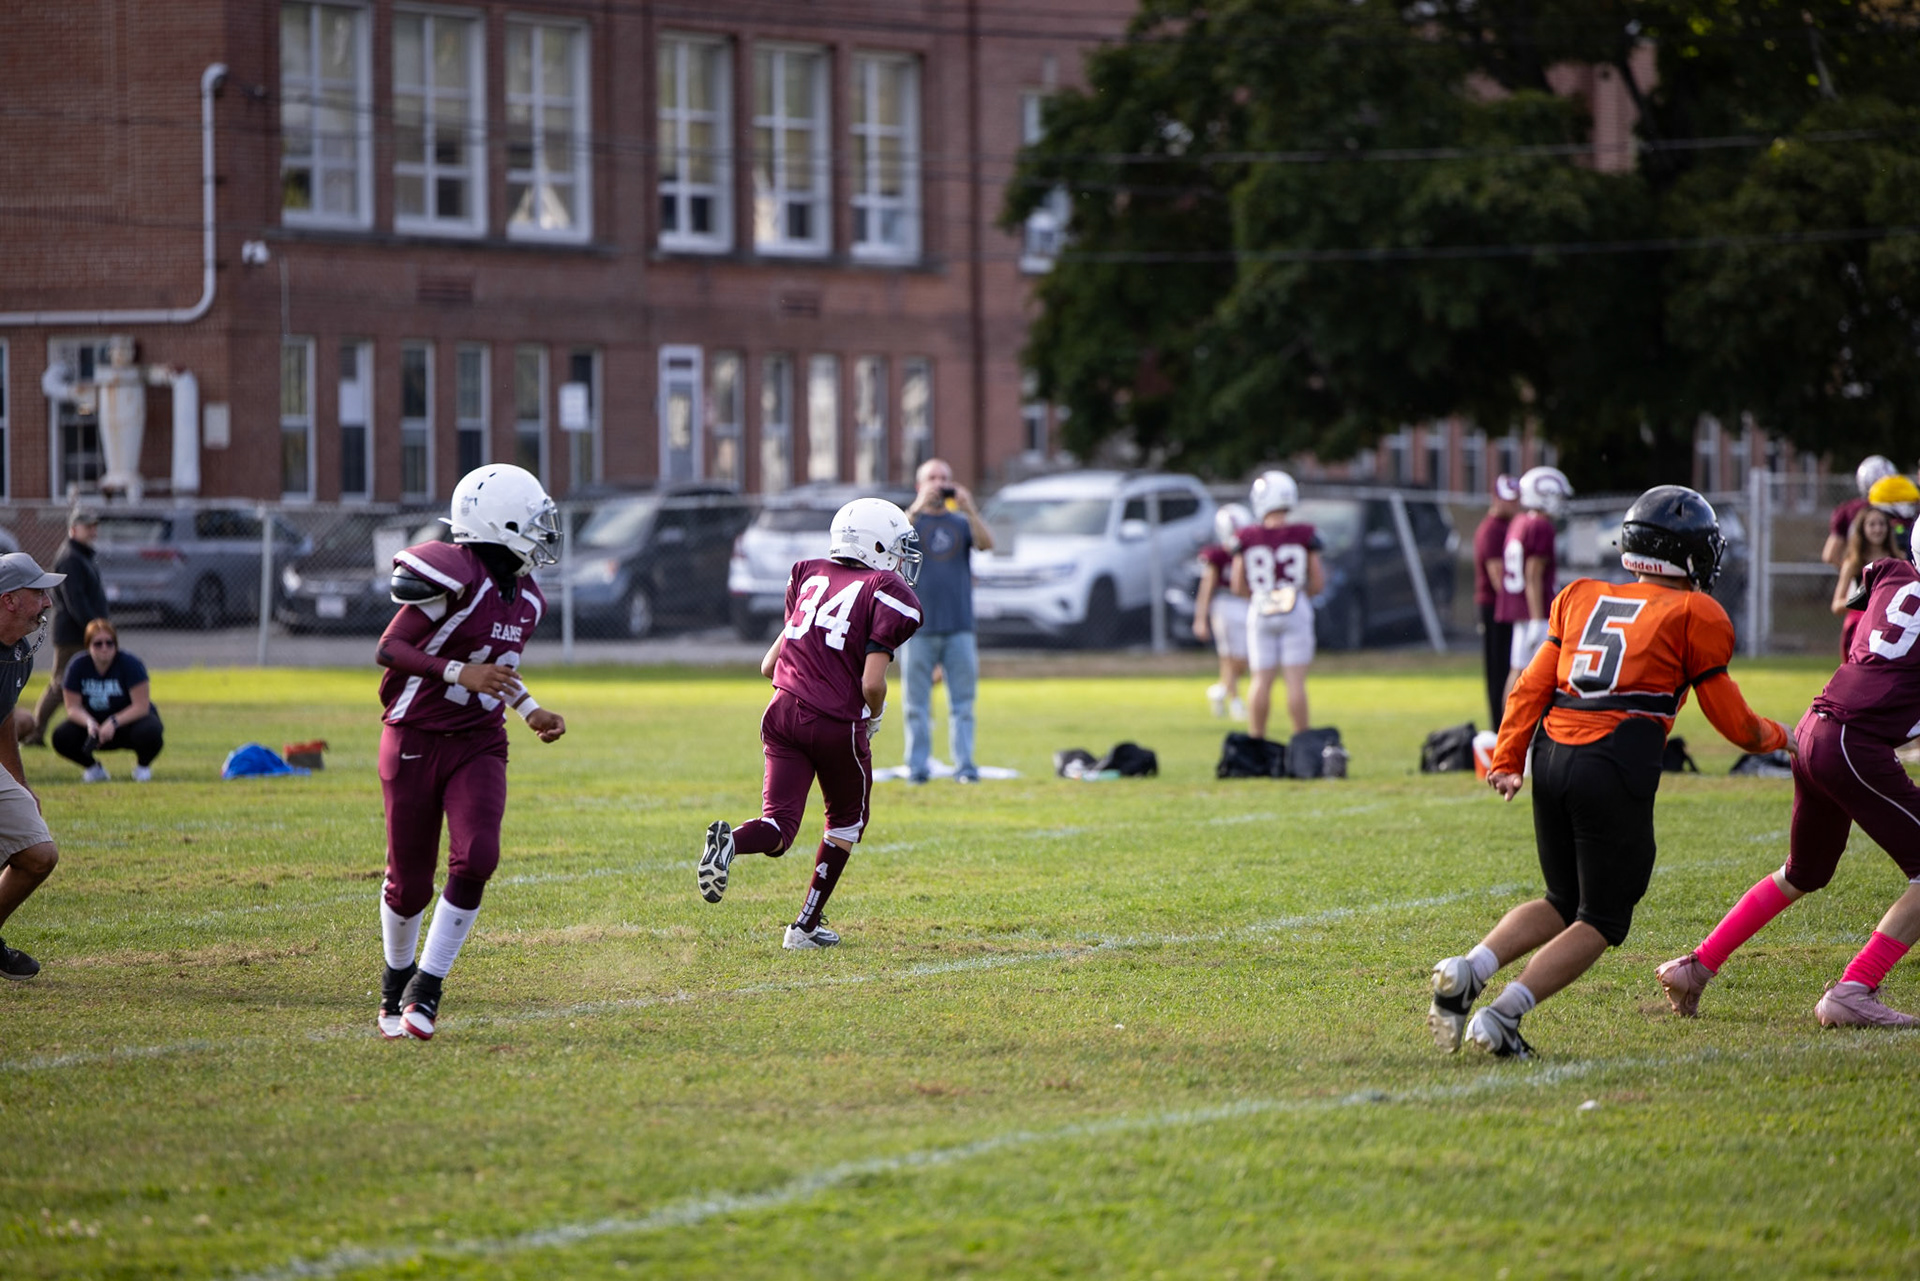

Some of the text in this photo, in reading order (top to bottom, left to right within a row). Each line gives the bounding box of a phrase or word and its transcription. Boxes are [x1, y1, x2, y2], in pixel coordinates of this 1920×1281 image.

[1244, 544, 1307, 592] 83
[1623, 559, 1663, 573] Riddell
[784, 575, 865, 650] 34
[1568, 594, 1648, 699] 5
[1868, 581, 1920, 660] 9
